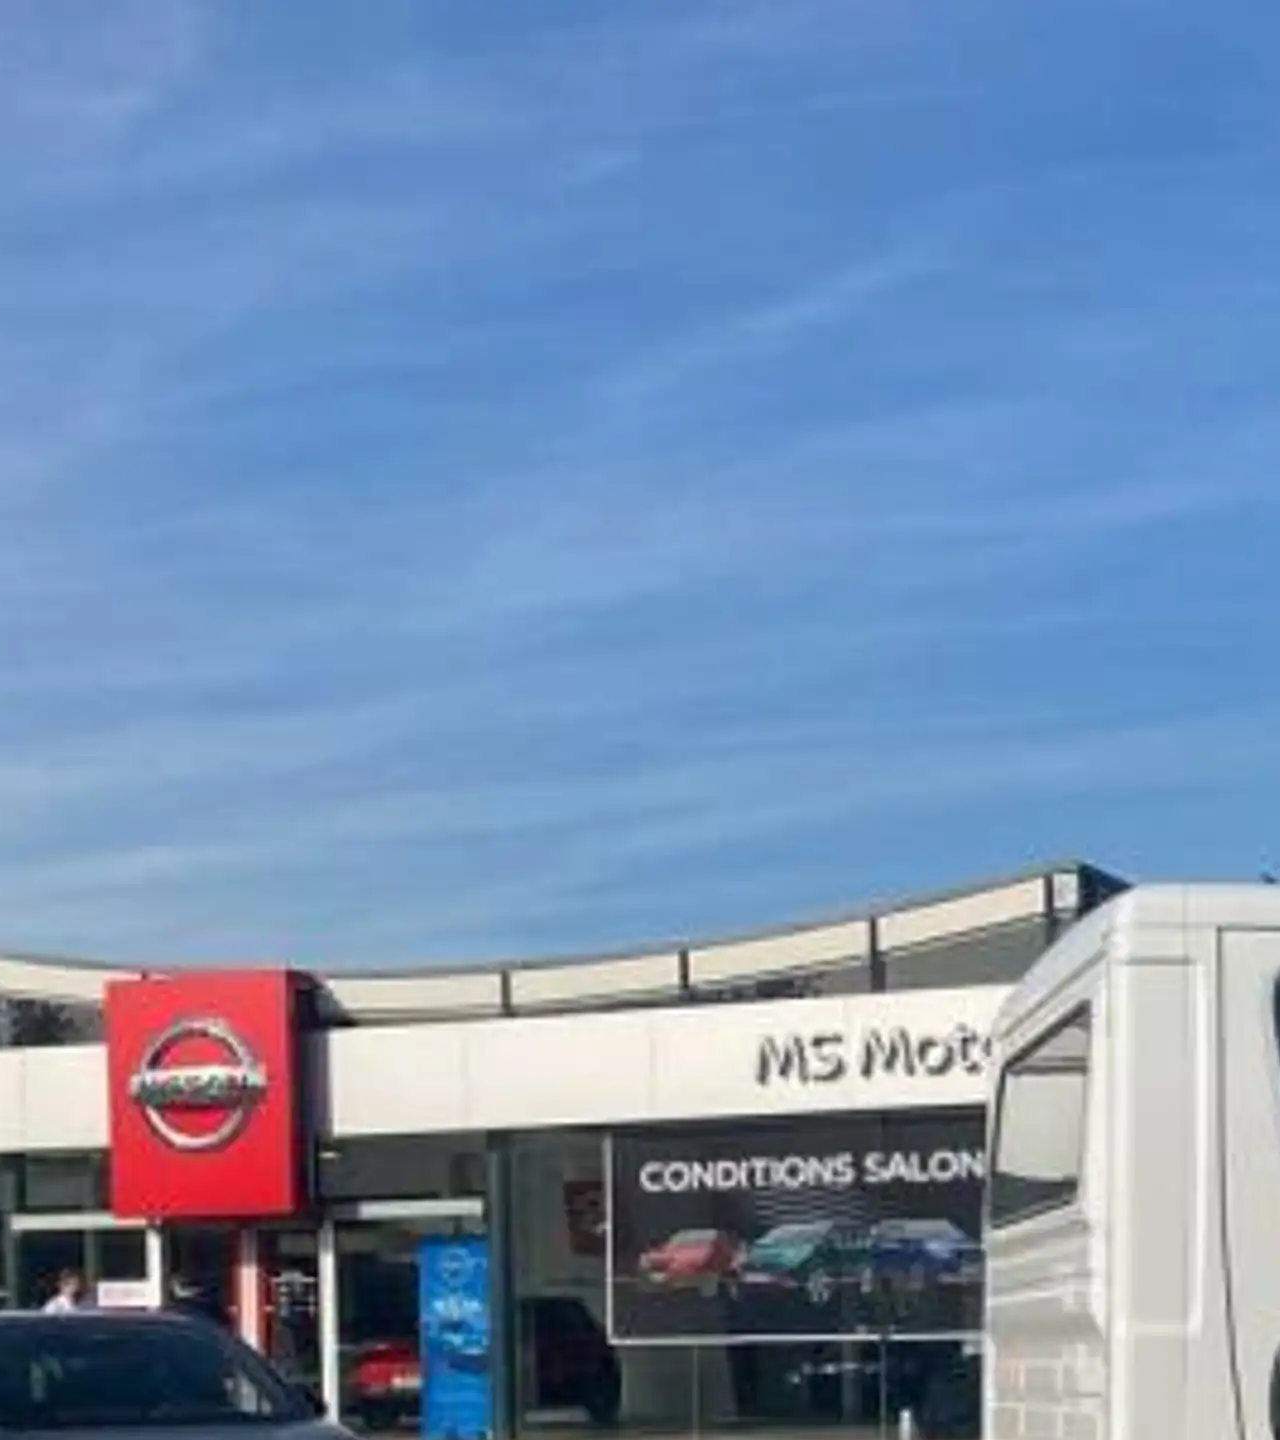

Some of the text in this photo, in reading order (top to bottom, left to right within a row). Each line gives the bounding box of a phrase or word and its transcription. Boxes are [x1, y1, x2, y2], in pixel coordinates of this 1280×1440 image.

[756, 1032, 846, 1086] MS
[640, 1149, 985, 1192] CONDITIONS SALON
